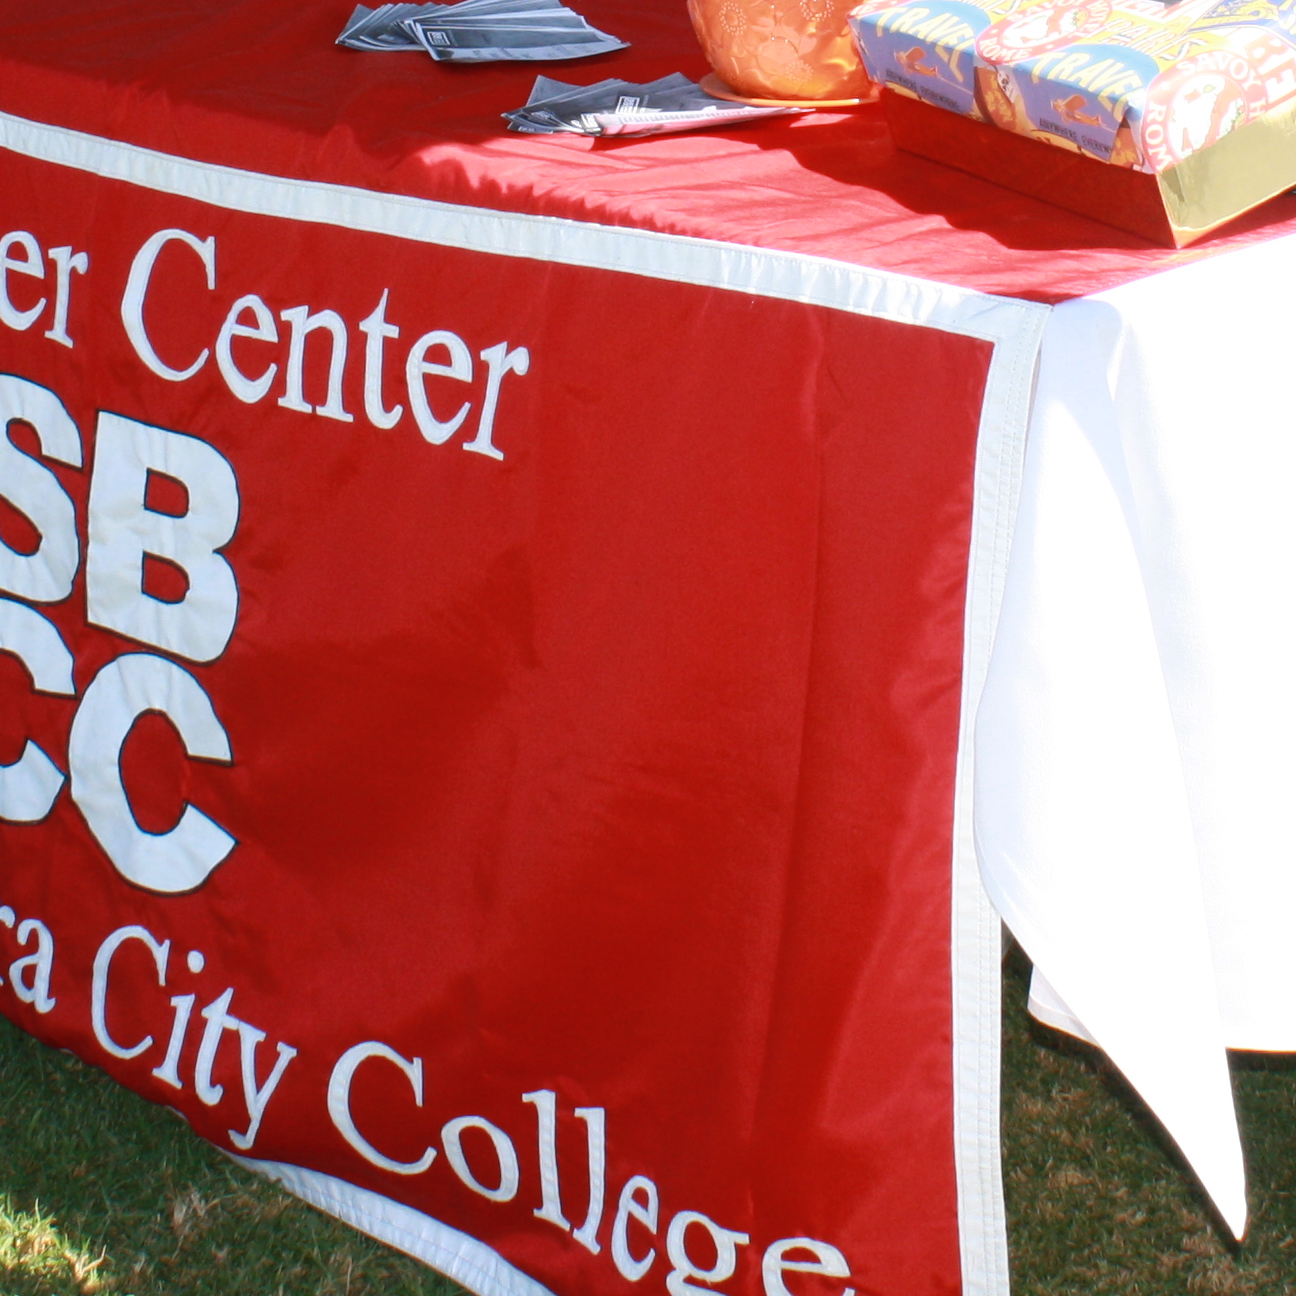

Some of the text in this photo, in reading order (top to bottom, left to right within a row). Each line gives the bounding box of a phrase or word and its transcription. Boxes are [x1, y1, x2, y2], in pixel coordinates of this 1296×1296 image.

[1145, 101, 1174, 171] ROM
[120, 227, 530, 461] Center
[89, 924, 297, 1151] City
[326, 1038, 854, 1296] College
